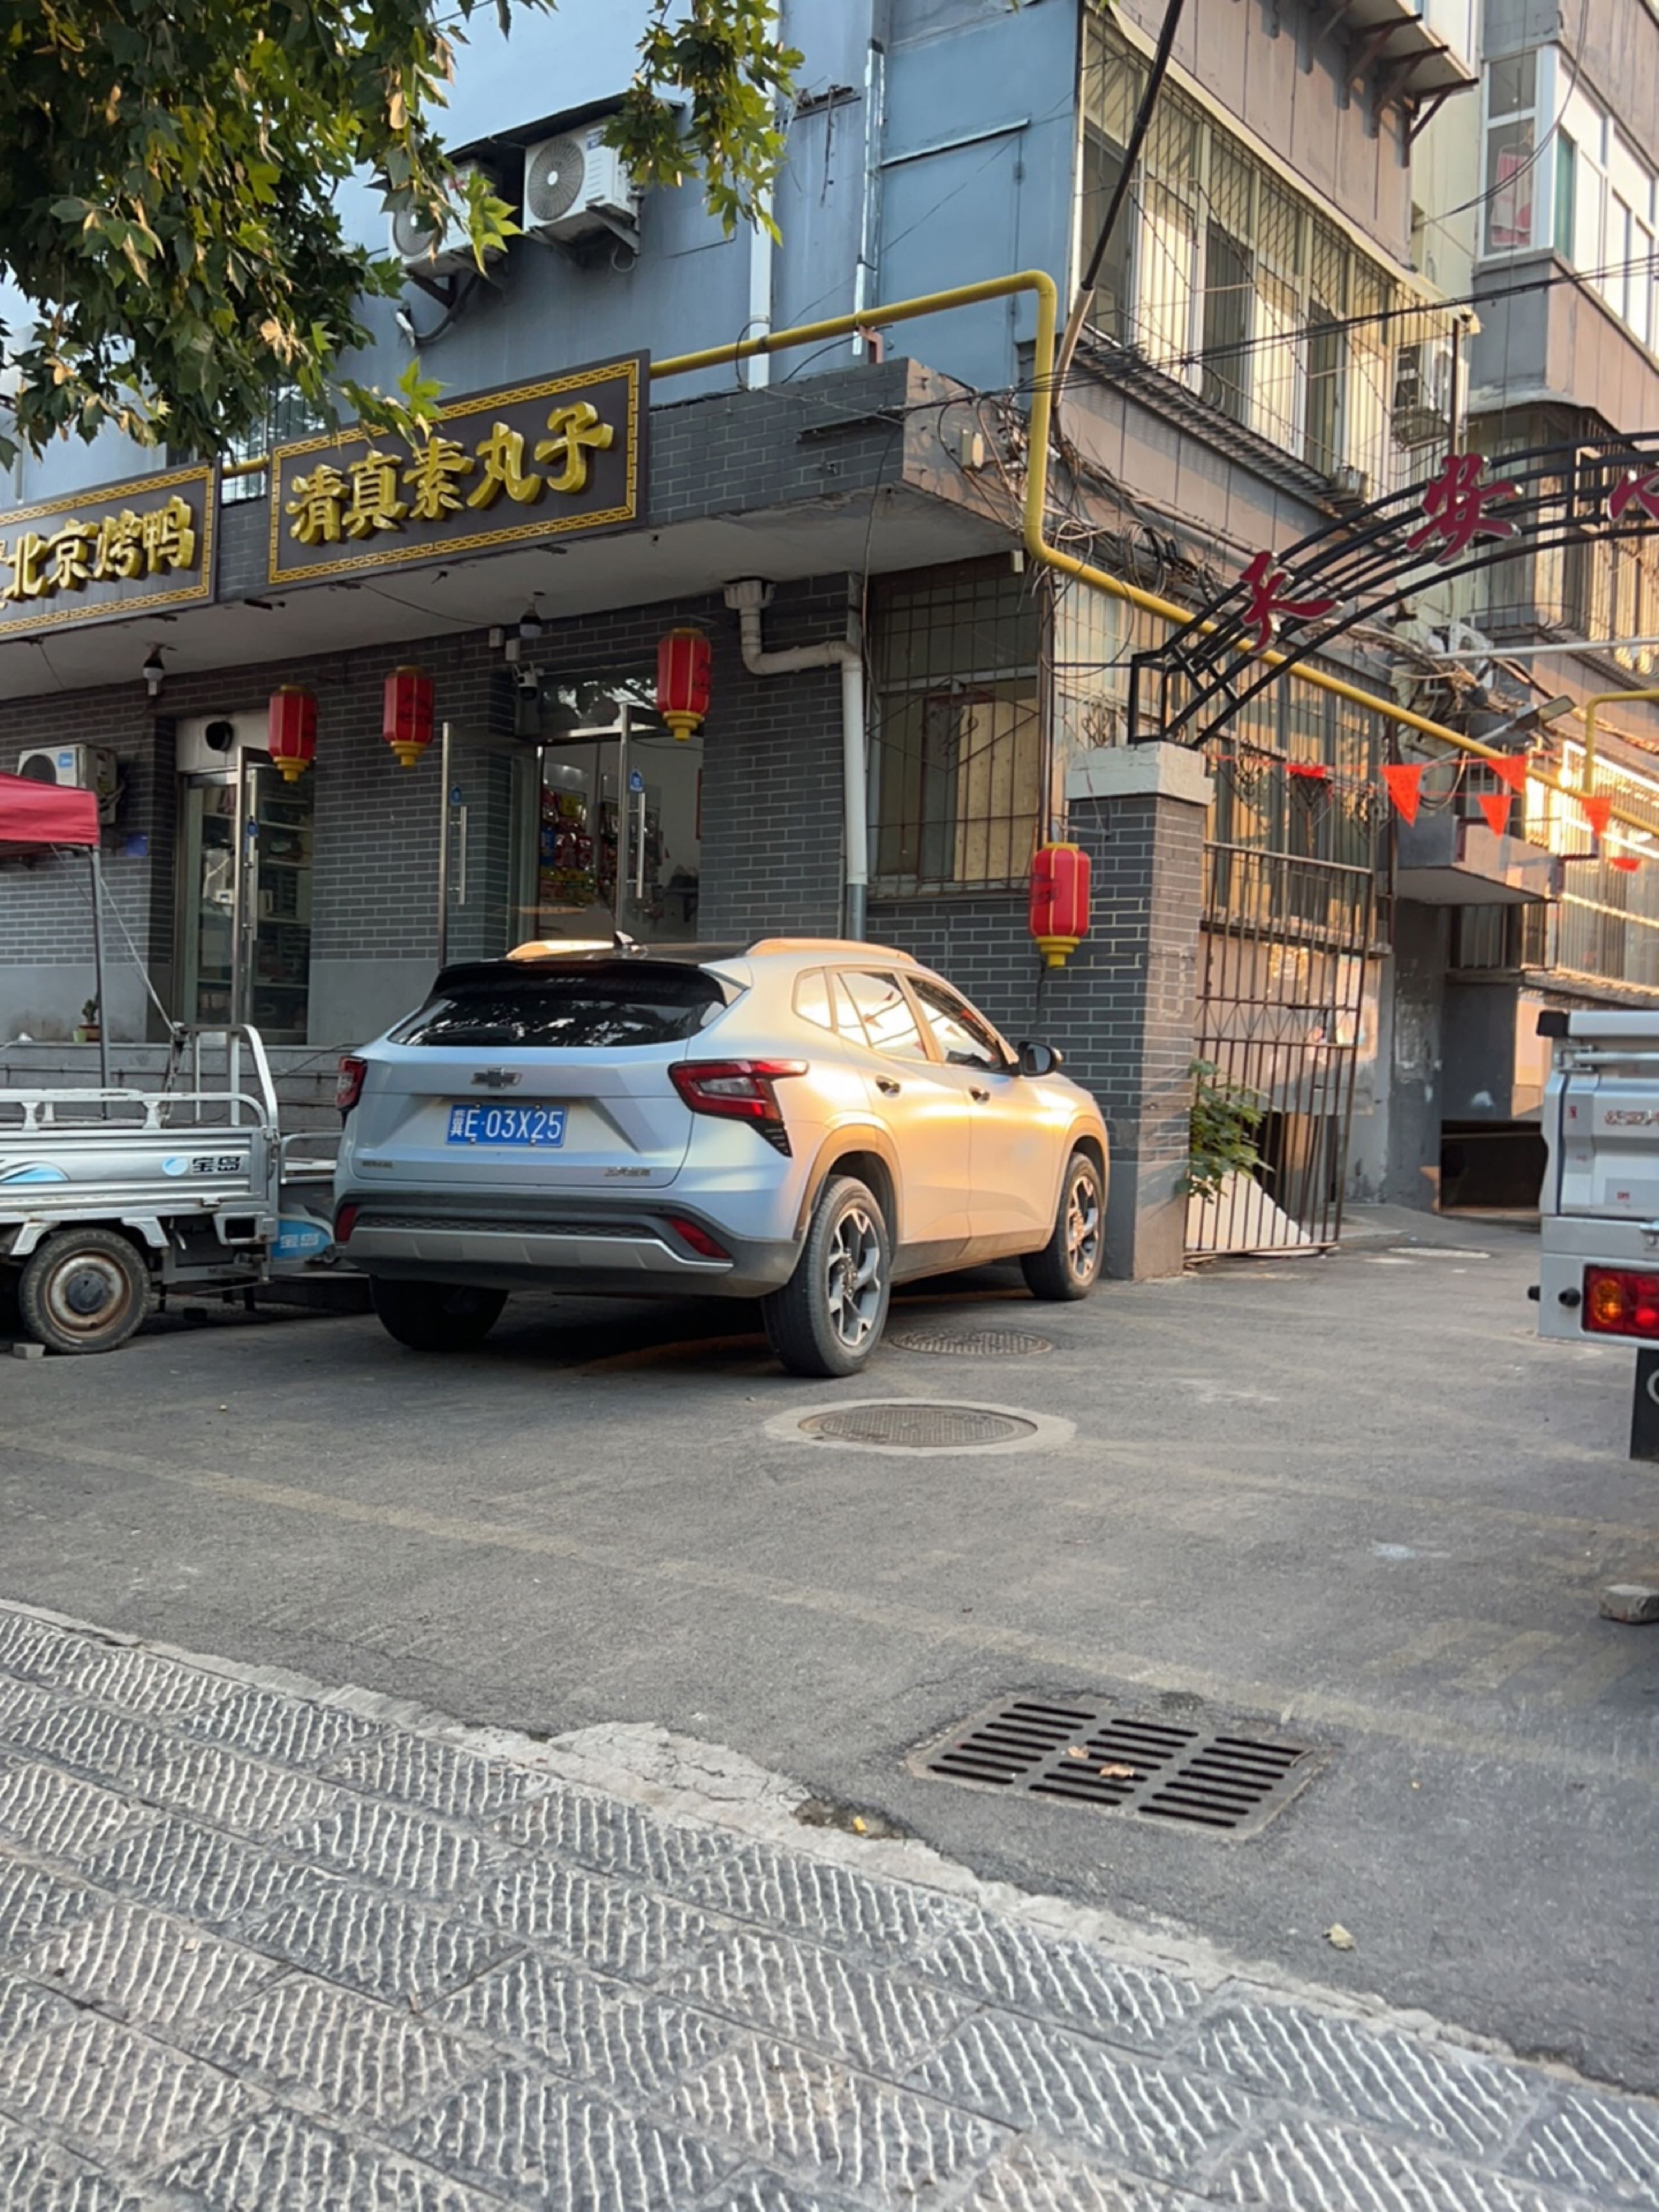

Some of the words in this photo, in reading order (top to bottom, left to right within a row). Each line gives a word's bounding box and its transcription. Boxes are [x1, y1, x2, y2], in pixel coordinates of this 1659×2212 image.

[286, 401, 613, 544] 清真素丸子
[0, 495, 195, 608] 北京烤鸭
[193, 1156, 241, 1172] 宝岛
